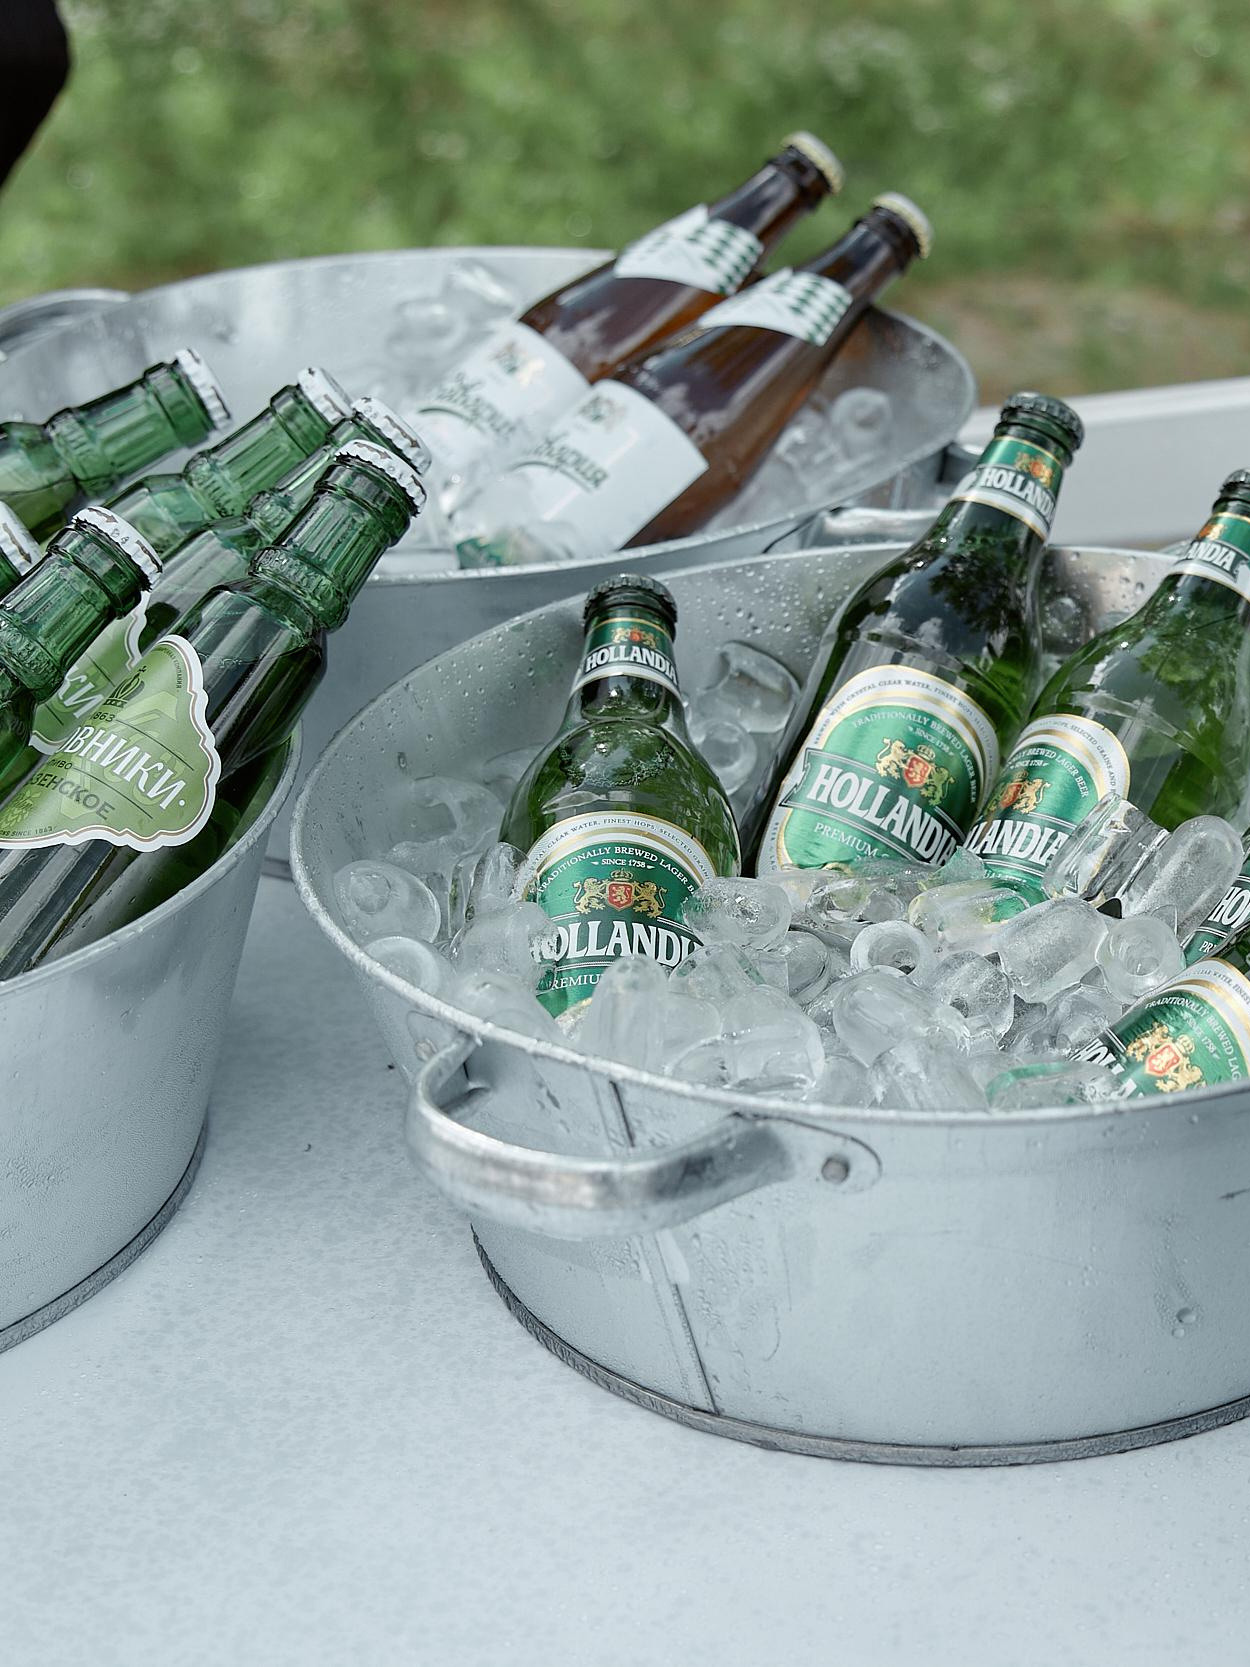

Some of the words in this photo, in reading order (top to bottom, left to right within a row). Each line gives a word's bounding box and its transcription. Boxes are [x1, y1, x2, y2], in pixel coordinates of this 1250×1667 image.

[585, 645, 678, 686] HOLLANDIA
[852, 711, 930, 728] TRADITIONALLY
[930, 720, 962, 749] BREWED
[960, 749, 976, 780] LAGER
[1071, 725, 1098, 746] SELECTED
[1056, 755, 1079, 777] LAGER
[1074, 776, 1089, 799] BEER
[547, 831, 569, 848] CLEAR
[660, 828, 692, 855] SELECTED
[814, 822, 879, 857] PREMIUM
[537, 846, 611, 893] TRADITIONALLY
[614, 846, 658, 862] BREWED
[659, 858, 688, 885] LAGER
[601, 858, 627, 867] SINCE
[628, 859, 646, 868] 1758
[1206, 1013, 1234, 1054] BREWED
[1227, 1056, 1242, 1082] LAG
